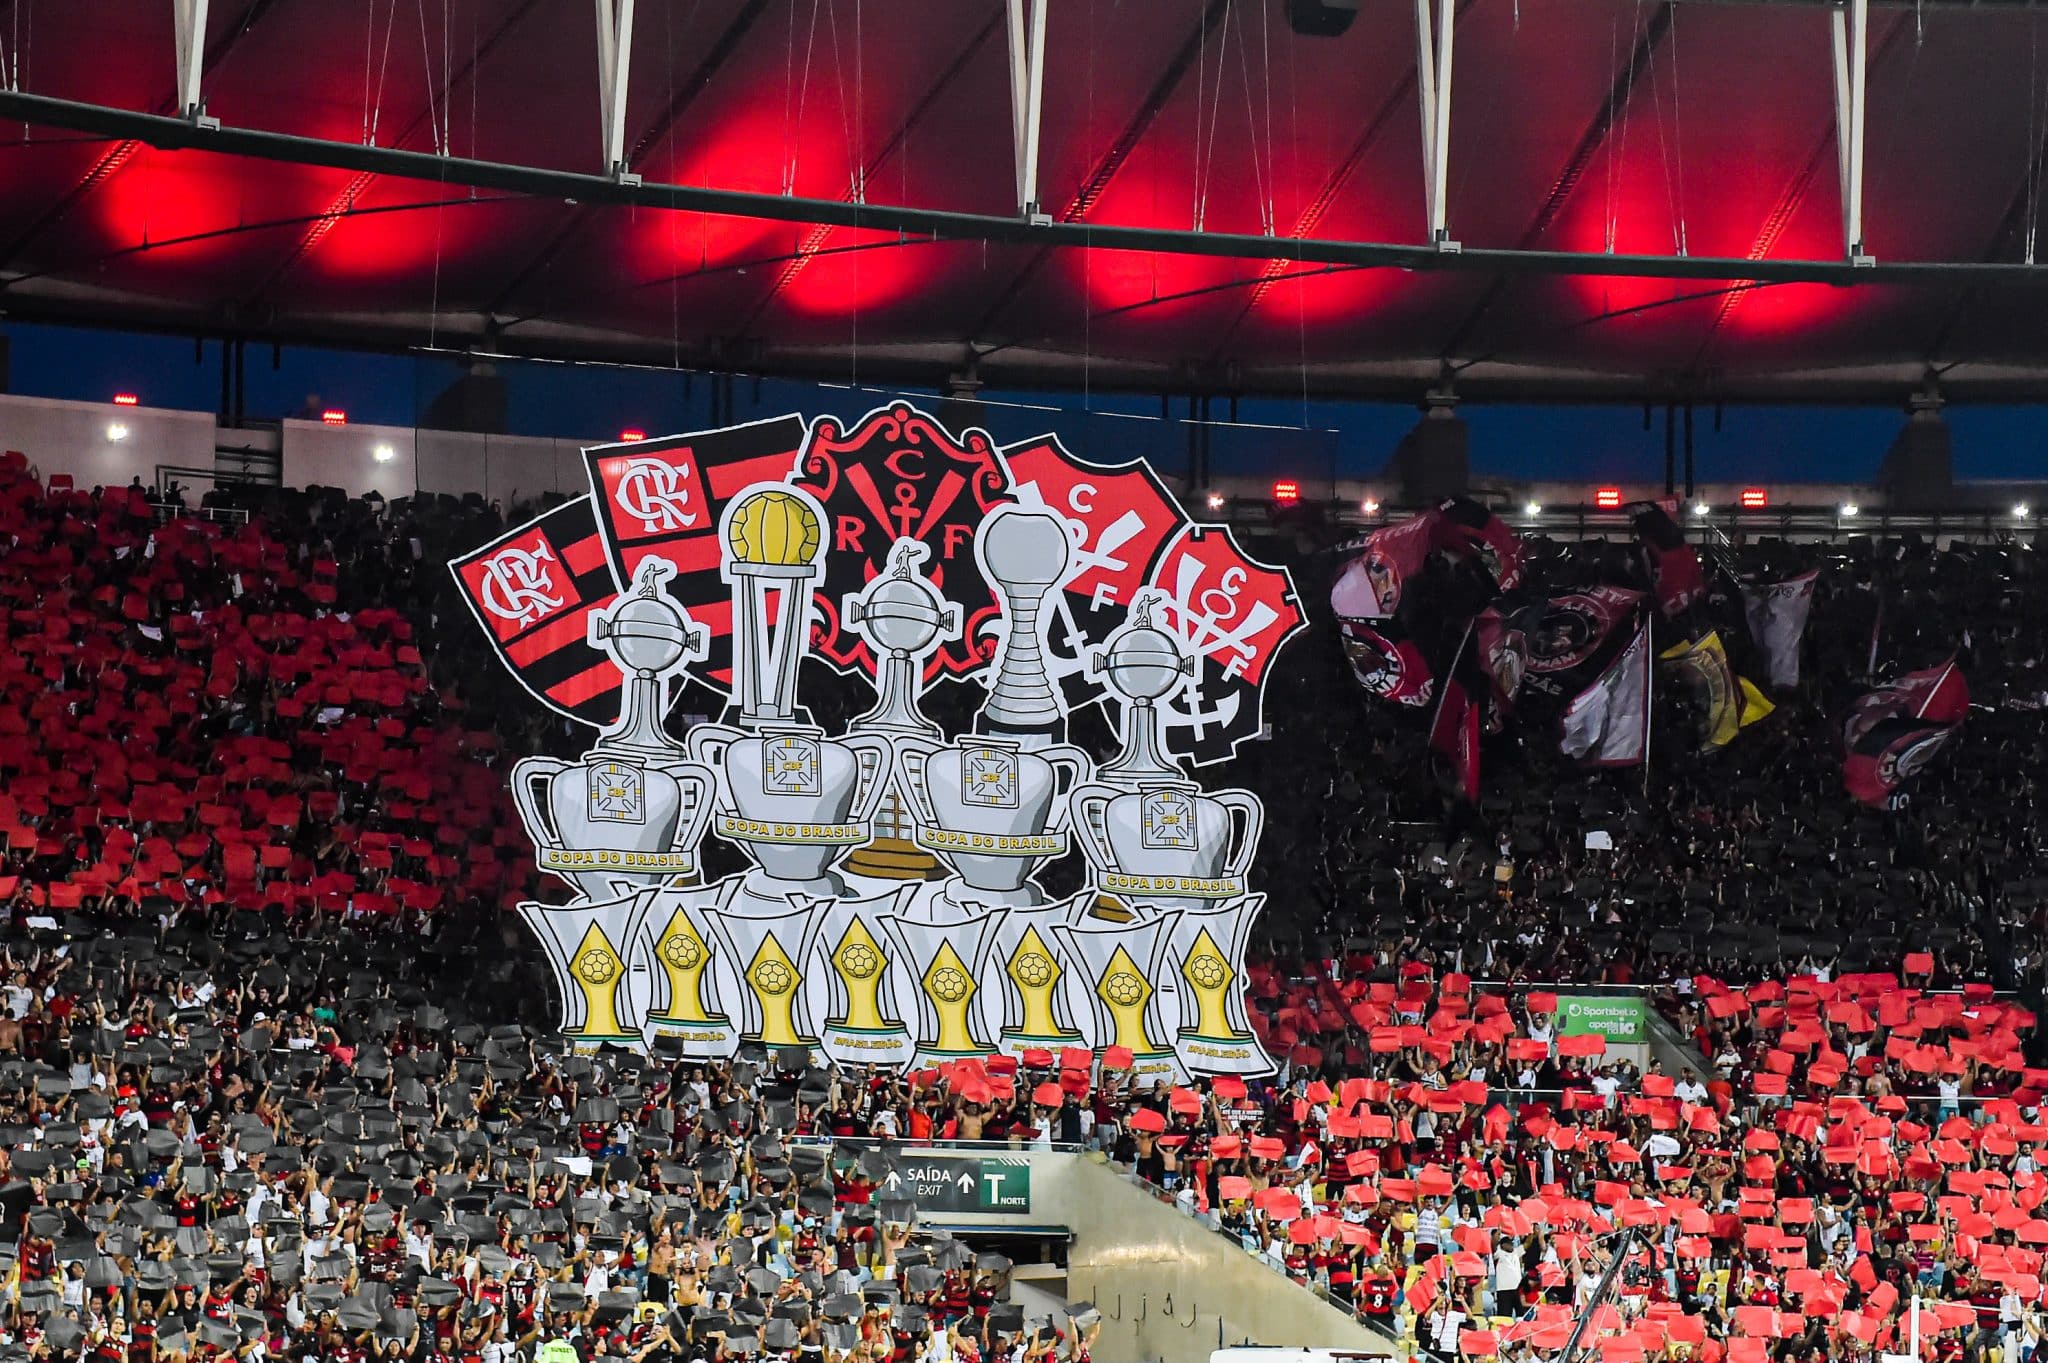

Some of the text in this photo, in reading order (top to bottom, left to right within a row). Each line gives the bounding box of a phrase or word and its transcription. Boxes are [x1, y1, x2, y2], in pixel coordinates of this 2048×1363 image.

[725, 819, 860, 837] COPA DO BRASIL
[925, 830, 1056, 849] COPA DO BRASIL
[549, 851, 684, 866] COPA DO BRASIL
[1106, 875, 1236, 891] COPA DO BRASIL
[1583, 1006, 1638, 1017] Sportsbet.io
[907, 1166, 951, 1182] SAÍDA
[917, 1184, 943, 1196] EXIT
[984, 1174, 1005, 1204] T
[1001, 1197, 1026, 1205] NORTE
[1373, 1293, 1384, 1308] 8
